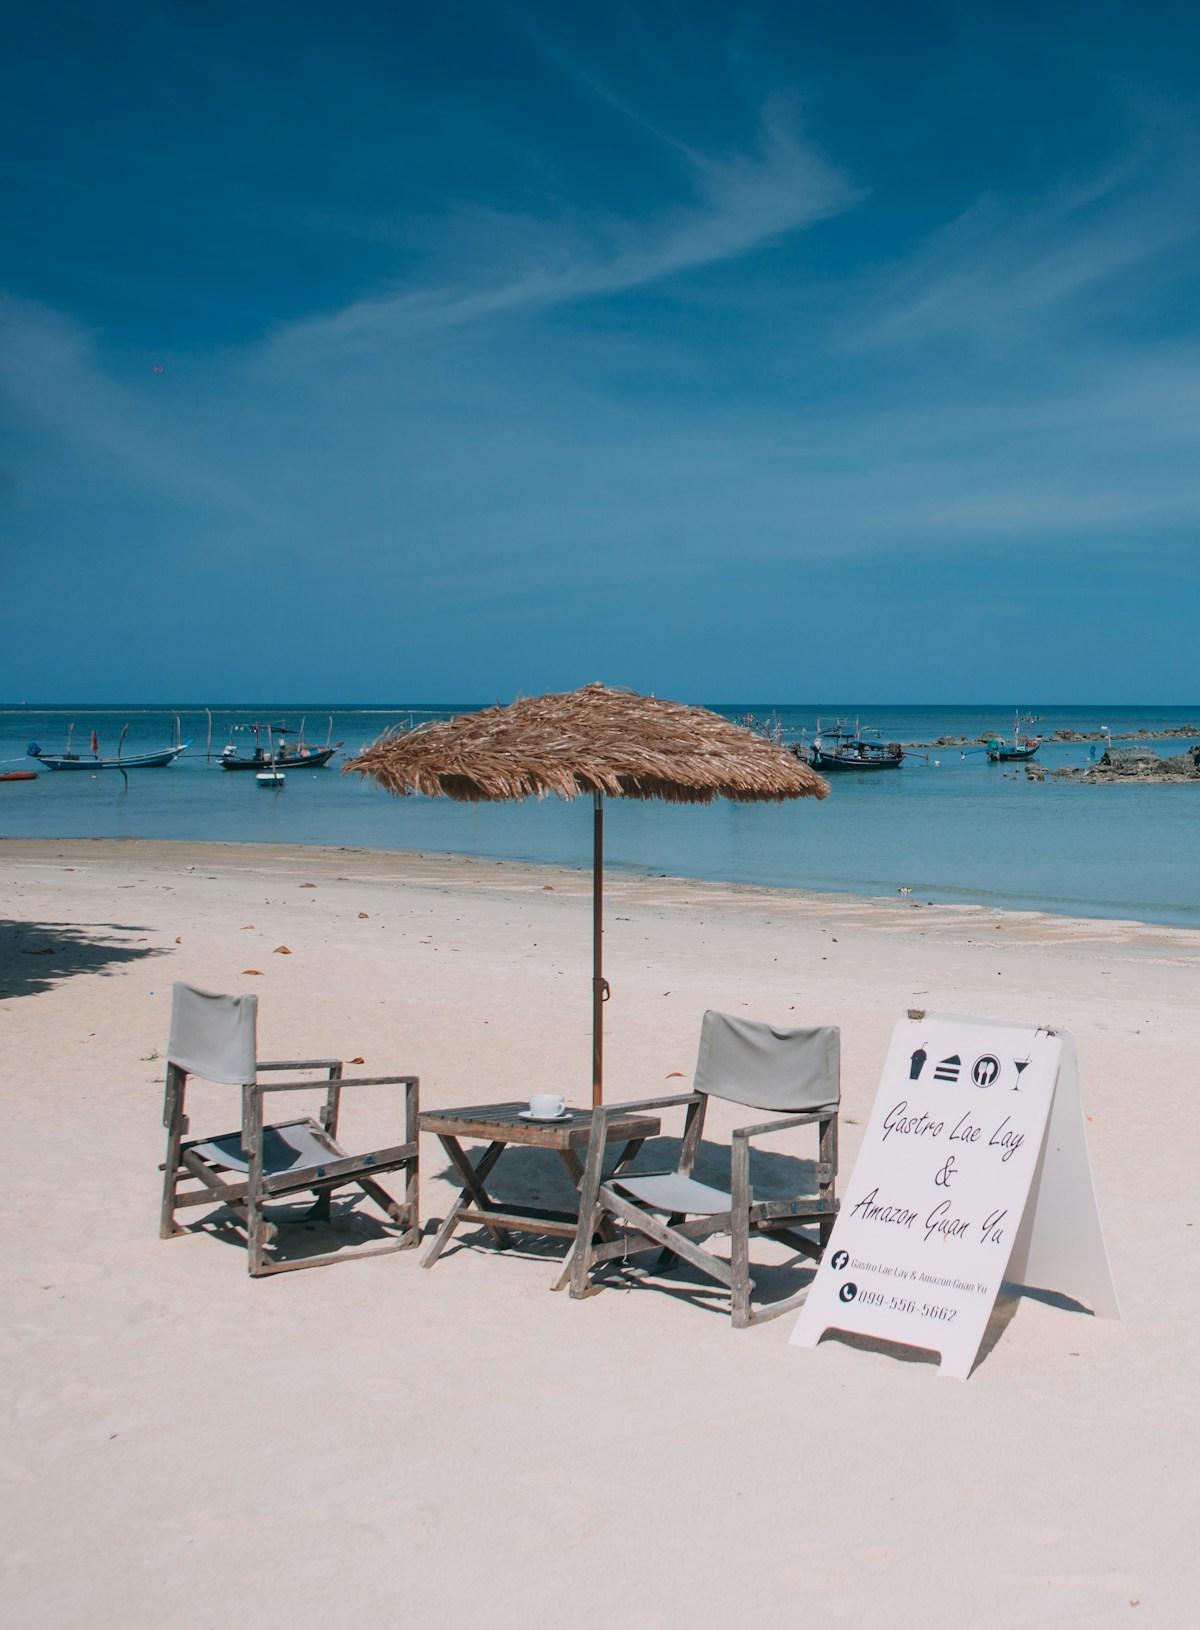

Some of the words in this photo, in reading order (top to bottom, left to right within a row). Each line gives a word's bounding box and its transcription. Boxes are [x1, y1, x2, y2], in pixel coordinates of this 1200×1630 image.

[883, 1101, 944, 1142] Gastro
[949, 1111, 981, 1142] Lae
[989, 1116, 1025, 1162] Lay
[935, 1155, 958, 1187] &
[850, 1188, 918, 1229] Amazon
[924, 1200, 970, 1241] Guan
[981, 1210, 1008, 1244] Yu
[851, 1259, 877, 1271] Gastro
[878, 1264, 893, 1276] Lae
[893, 1266, 909, 1280] Lay
[910, 1271, 917, 1280] &
[919, 1272, 951, 1287] Amazon
[953, 1279, 974, 1292] Guan
[976, 1283, 988, 1294] Yu
[858, 1290, 957, 1322] 099-556-5662
